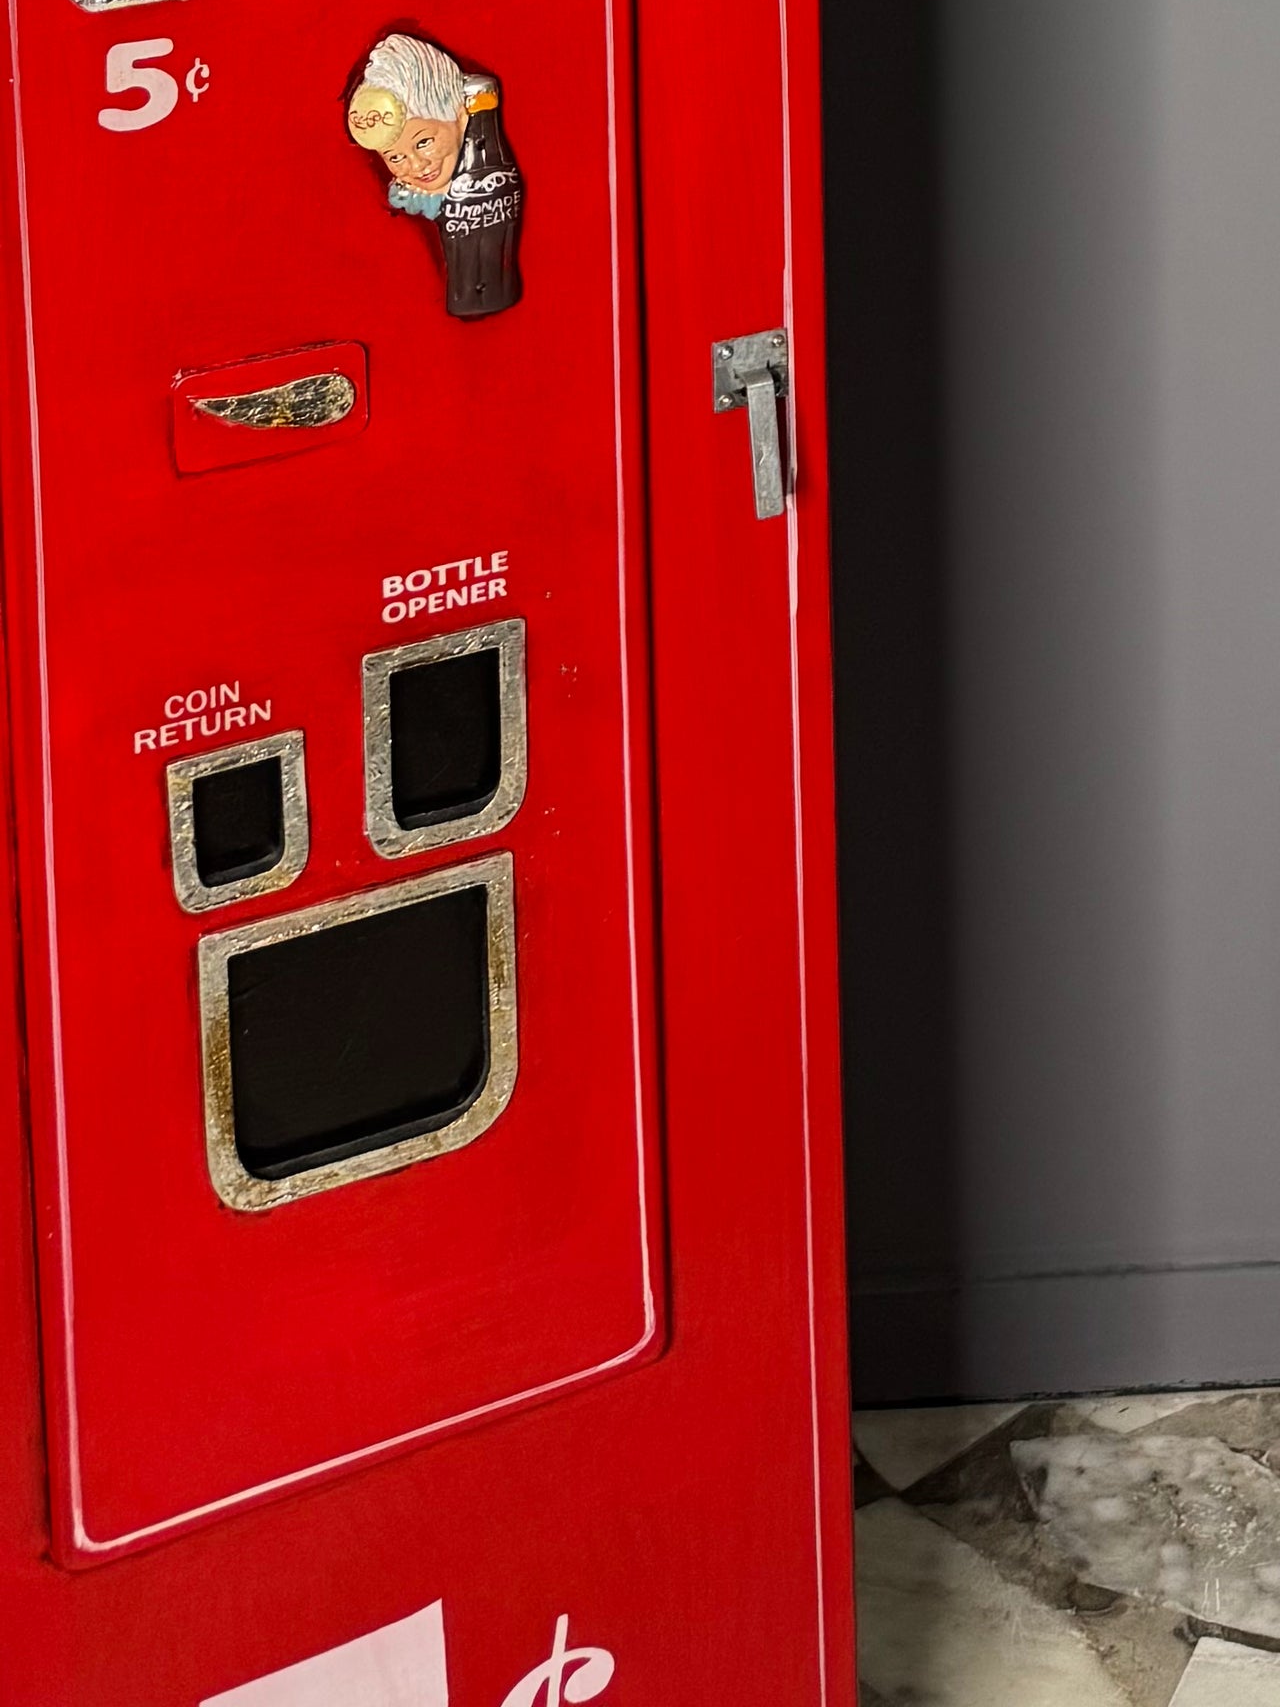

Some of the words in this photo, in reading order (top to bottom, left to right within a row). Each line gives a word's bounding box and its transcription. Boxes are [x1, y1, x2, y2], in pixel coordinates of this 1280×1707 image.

[382, 550, 509, 599] BOTTLE
[381, 577, 508, 624] OPENER
[163, 680, 240, 720] COIN
[133, 699, 272, 755] RETURN
